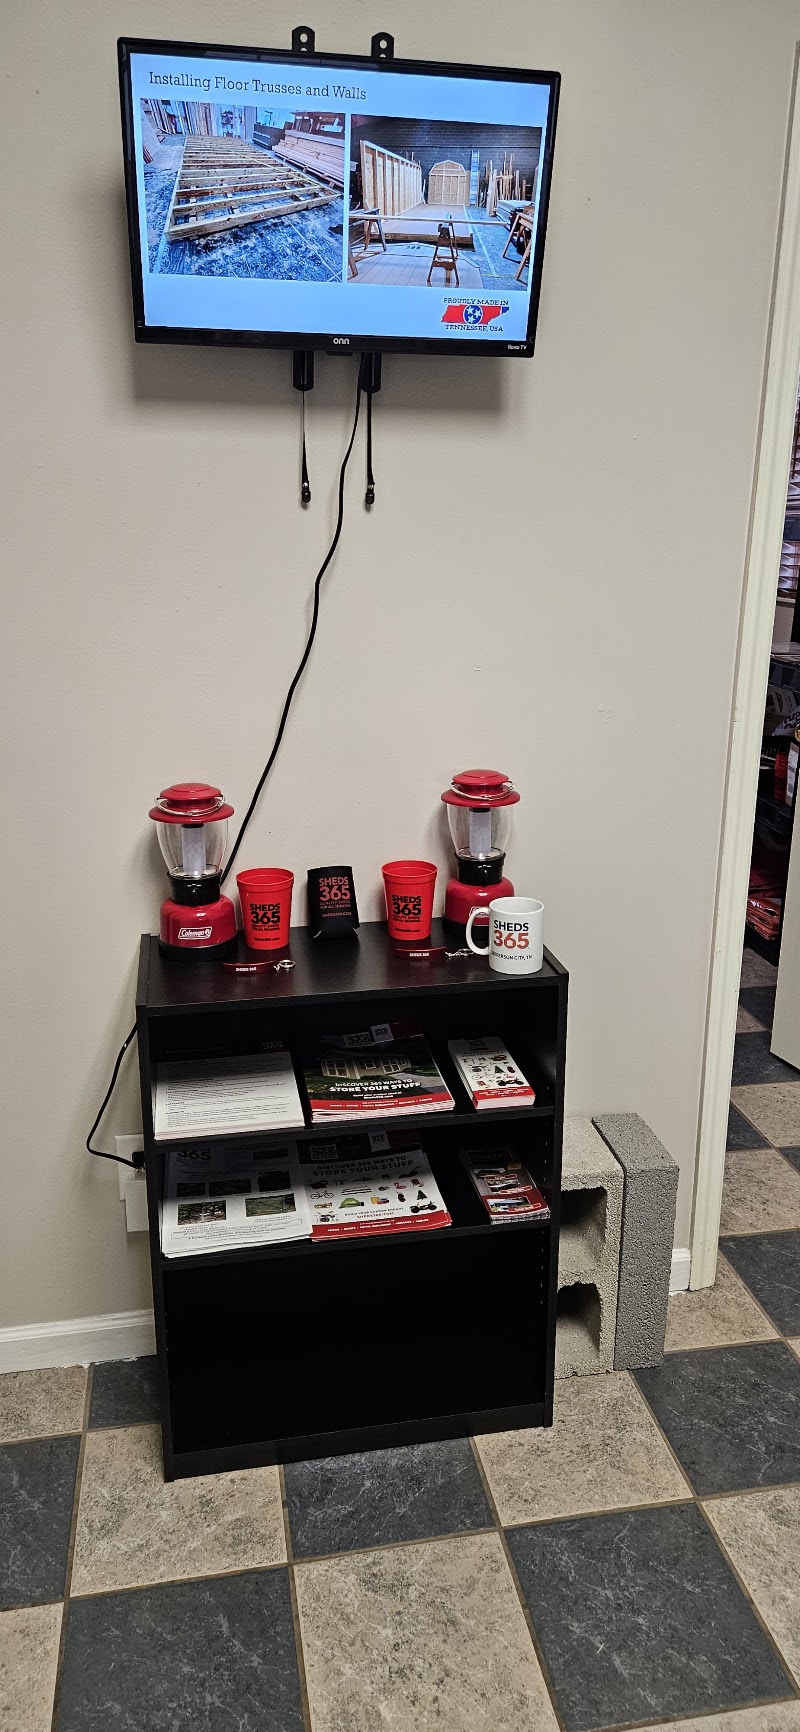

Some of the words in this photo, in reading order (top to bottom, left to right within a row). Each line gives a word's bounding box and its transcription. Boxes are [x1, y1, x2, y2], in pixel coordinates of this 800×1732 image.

[149, 72, 211, 92] Installing
[214, 77, 250, 91] Floor
[252, 79, 302, 95] Trusses
[305, 84, 330, 97] and
[332, 85, 367, 100] Walls
[443, 297, 476, 305] PROUDLY
[445, 324, 489, 332] TENNESSEE,
[333, 337, 350, 345] onn
[319, 876, 349, 886] SHEDS
[319, 884, 351, 901] 365
[392, 894, 422, 904] SHEDS
[249, 903, 281, 911] SHEDS
[392, 902, 422, 916] 365
[250, 910, 281, 925] 365
[493, 919, 530, 931] SHEDS
[181, 929, 205, 937] Coleman
[493, 929, 530, 949] 365
[312, 1168, 346, 1177] STORE
[349, 1165, 378, 1173] YOUR
[381, 1160, 413, 1169] STUFF
[317, 1162, 356, 1171] DISCOVER
[372, 1157, 395, 1165] WAYS
